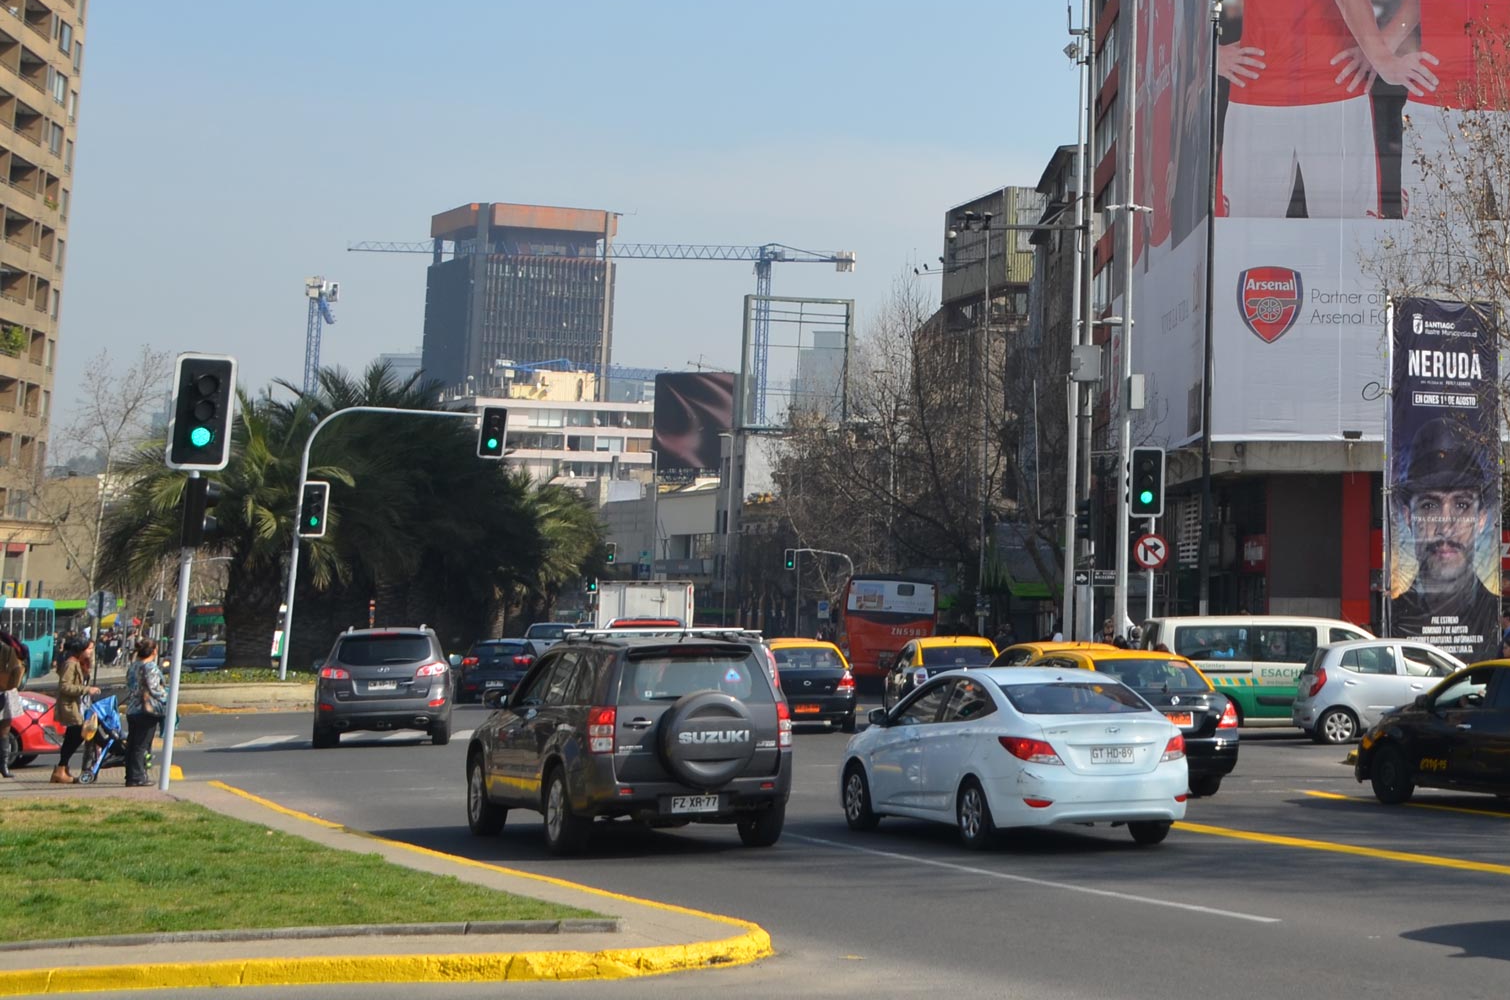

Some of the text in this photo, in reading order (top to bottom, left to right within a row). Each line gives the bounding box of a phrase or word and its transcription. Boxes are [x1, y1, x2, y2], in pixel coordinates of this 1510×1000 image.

[1246, 278, 1294, 291] Arsenal
[1311, 288, 1363, 304] Partner
[1310, 309, 1364, 324] Arsenal
[1424, 321, 1455, 329] SANTIAGO
[1408, 349, 1482, 380] NERUDA
[1415, 394, 1423, 403] EN
[1423, 394, 1439, 404] CINES
[1448, 396, 1455, 405] DE
[1455, 396, 1476, 406] AGOSTO
[679, 730, 750, 744] SUZUKI
[1092, 748, 1104, 758] GT
[673, 798, 686, 808] FZ
